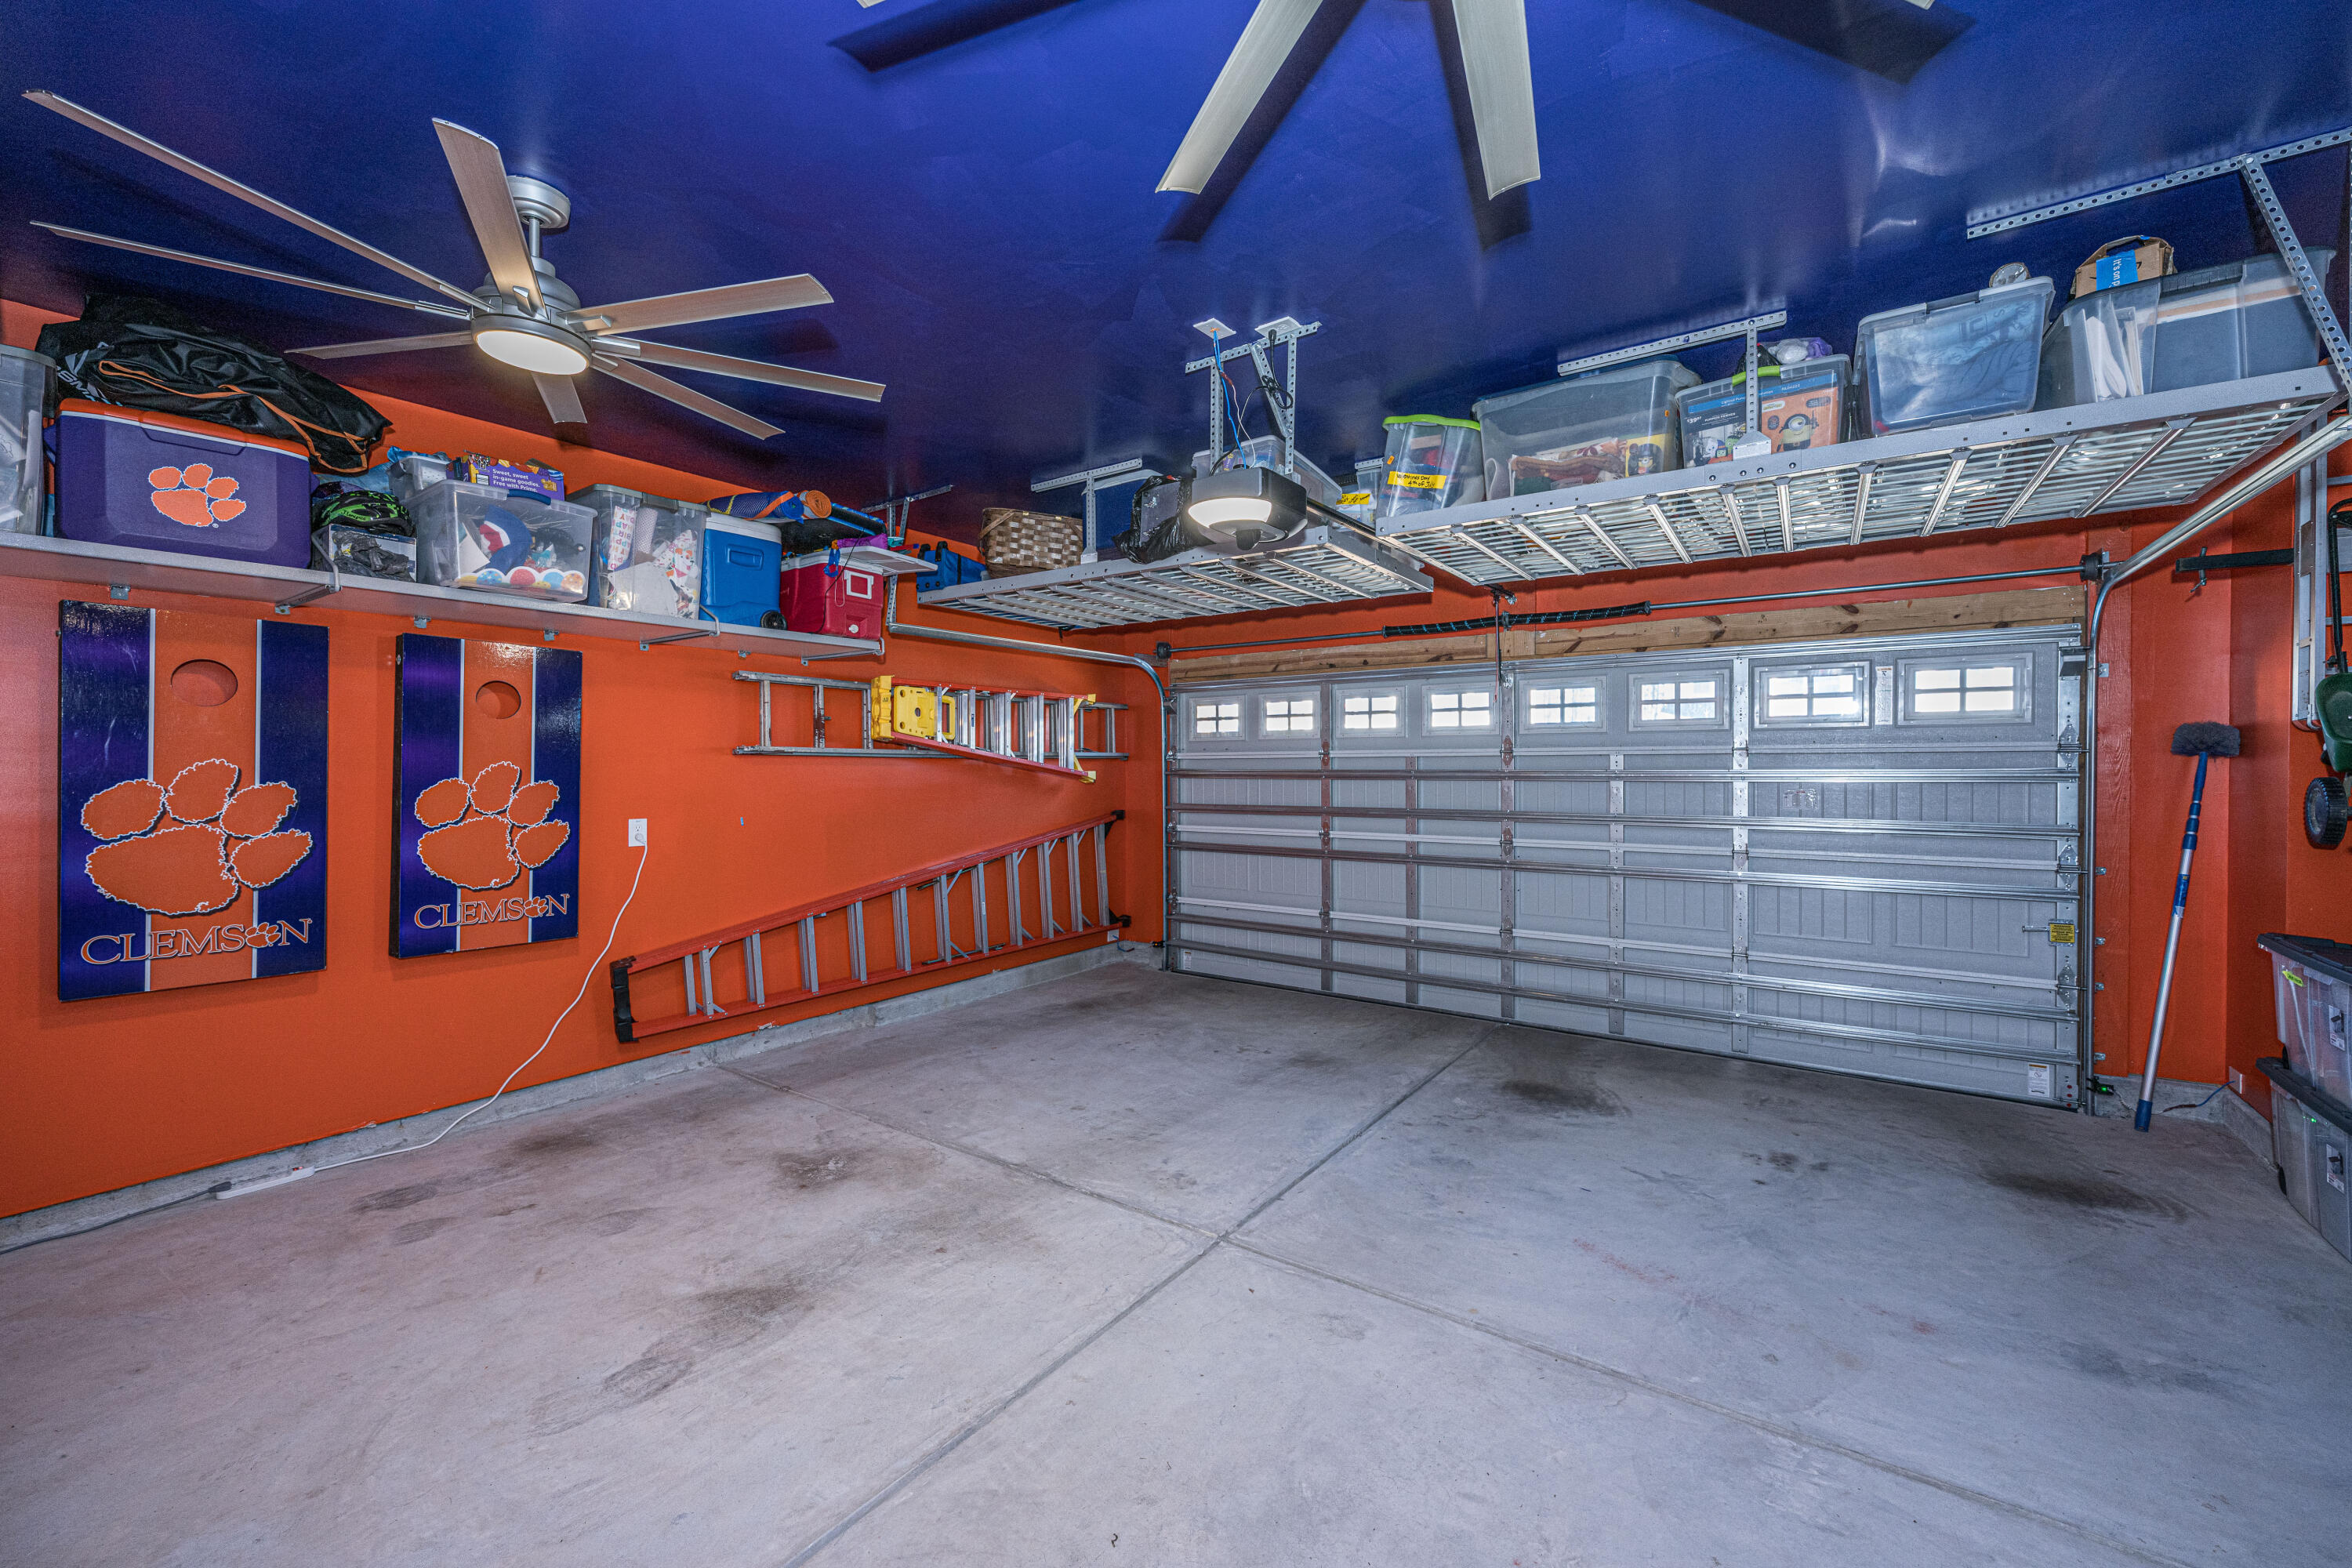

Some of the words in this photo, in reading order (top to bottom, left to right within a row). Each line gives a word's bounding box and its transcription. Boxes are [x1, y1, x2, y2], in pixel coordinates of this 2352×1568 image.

[2114, 271, 2120, 281] on
[492, 469, 511, 477] Sweet,
[493, 474, 517, 485] in-game
[517, 479, 540, 488] goodies.
[414, 894, 570, 929] CLEMSON
[81, 917, 312, 964] CLEMSON
